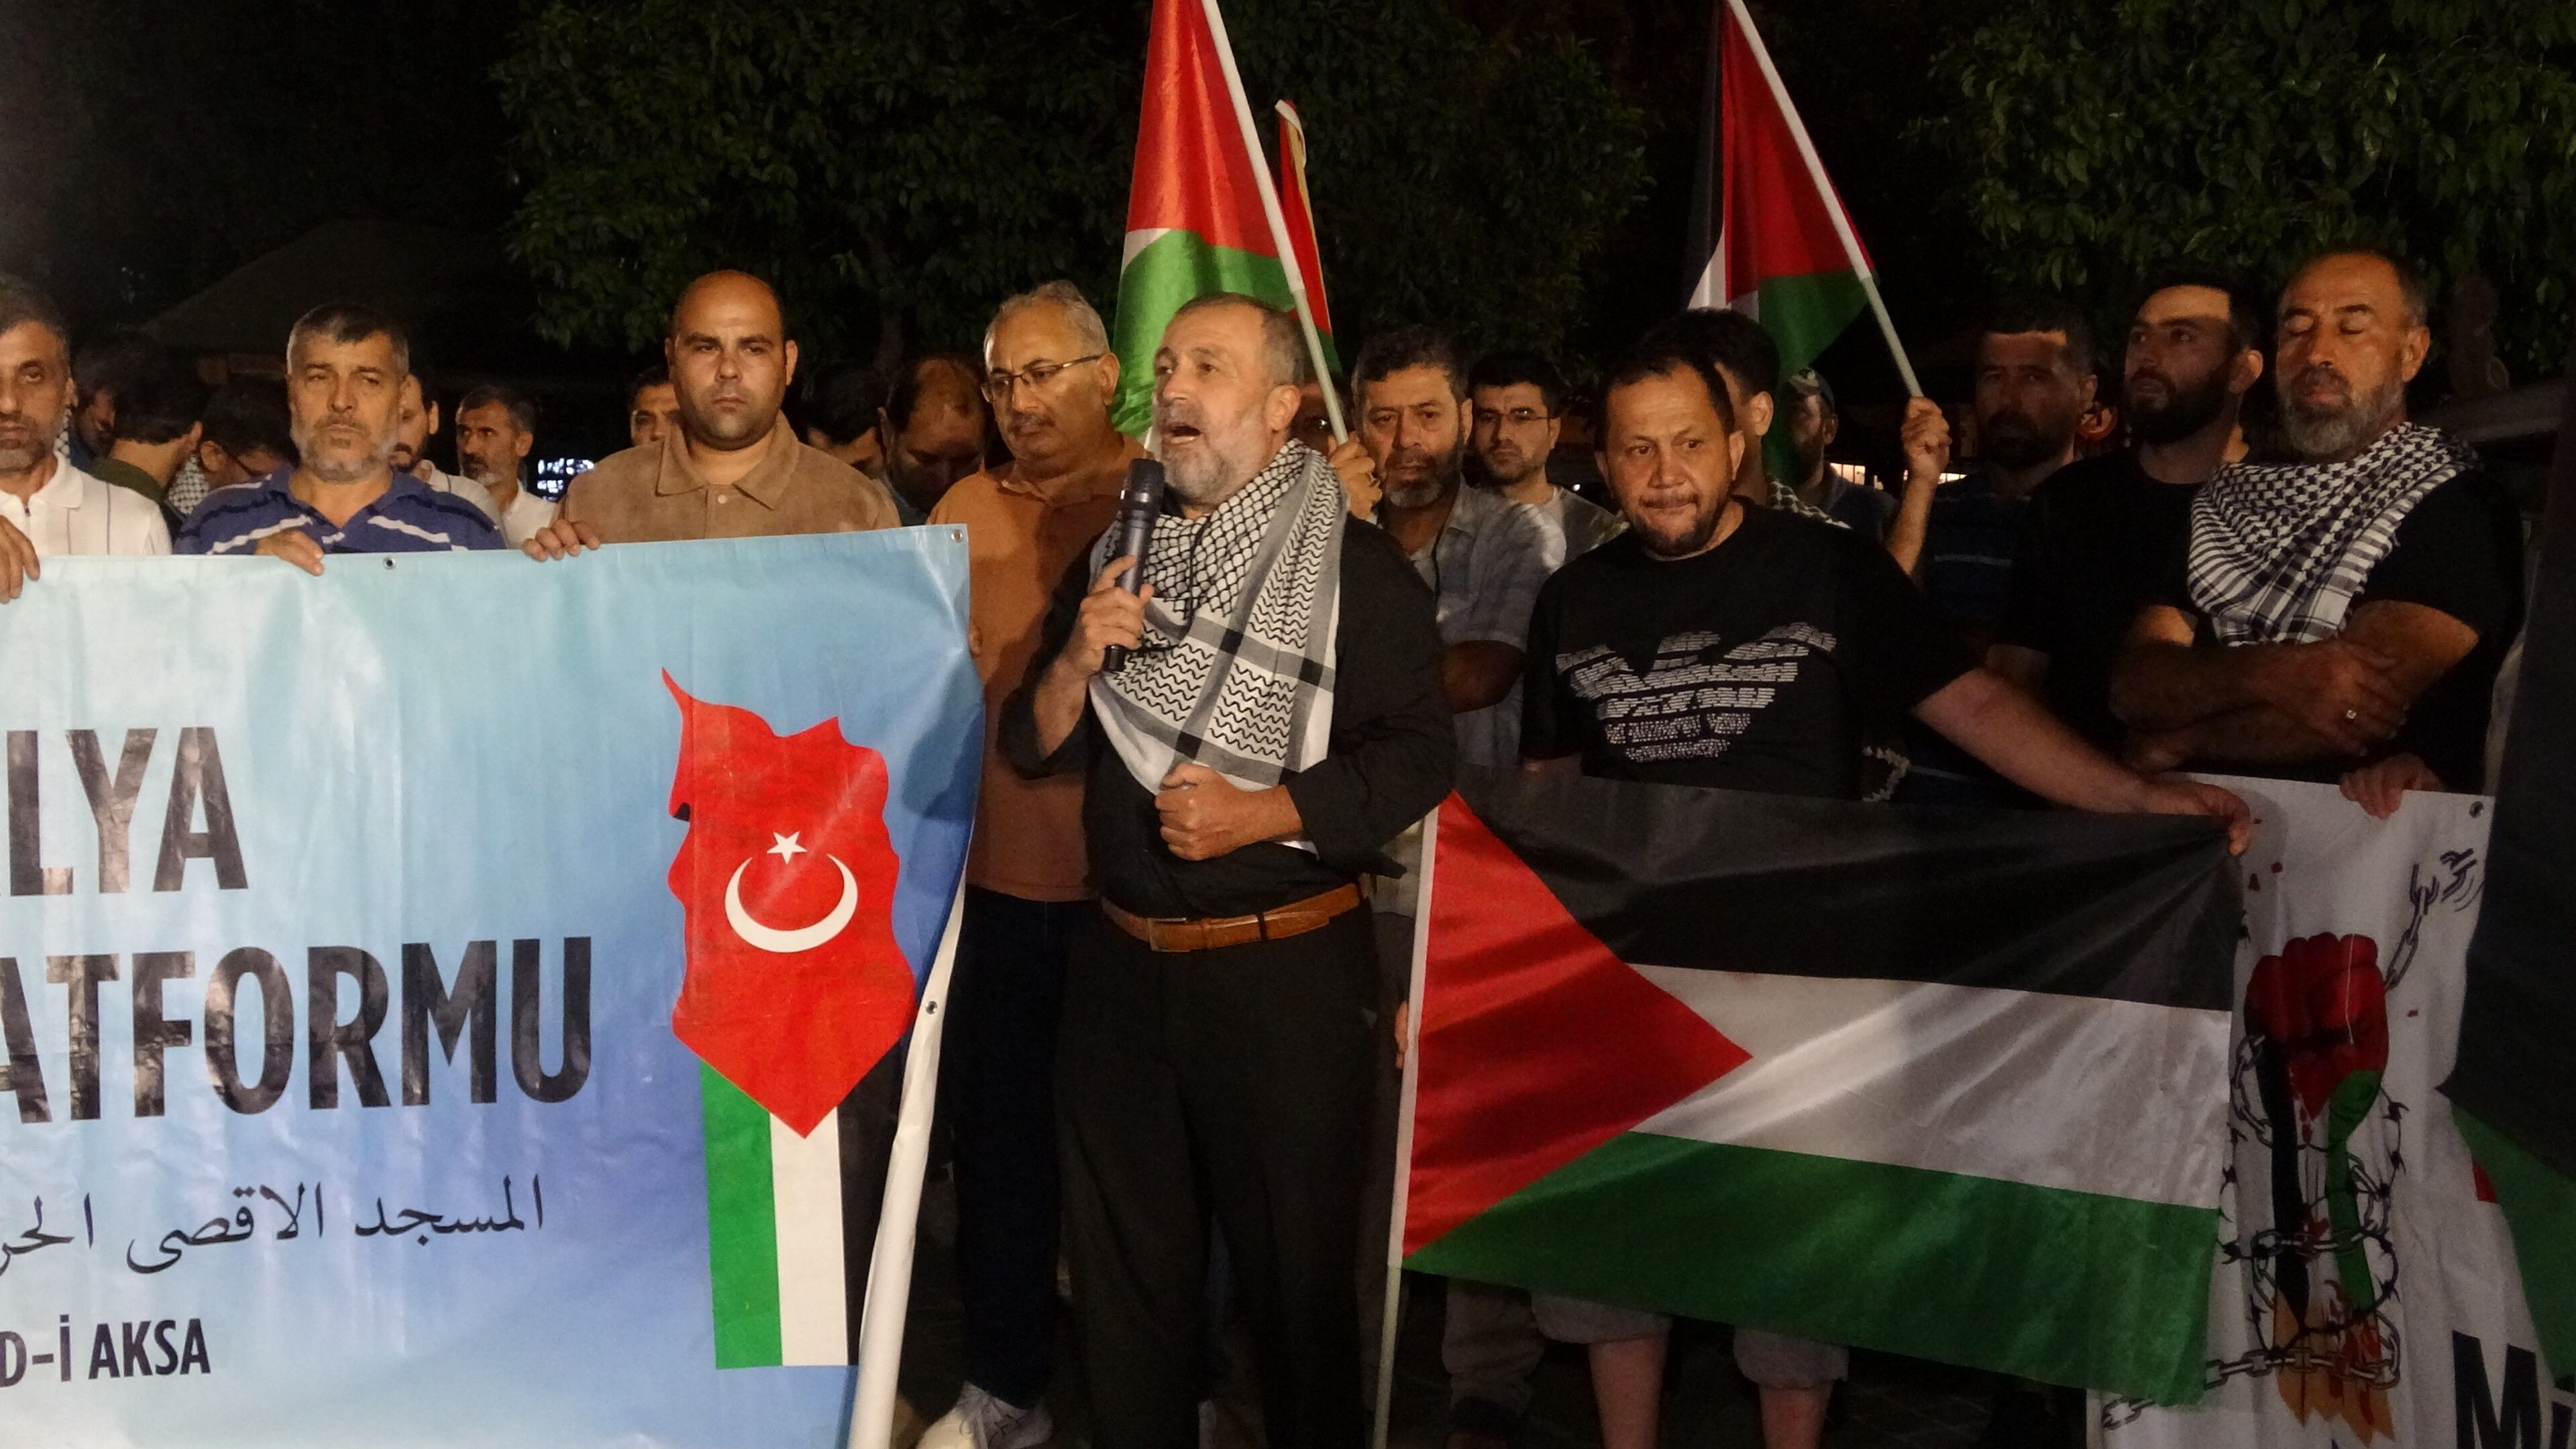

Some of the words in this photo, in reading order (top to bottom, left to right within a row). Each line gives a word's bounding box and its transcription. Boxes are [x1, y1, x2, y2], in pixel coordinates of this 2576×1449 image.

[7, 727, 248, 896] LYA
[355, 1174, 543, 1247] المسجد
[89, 1318, 211, 1380] AKSA
